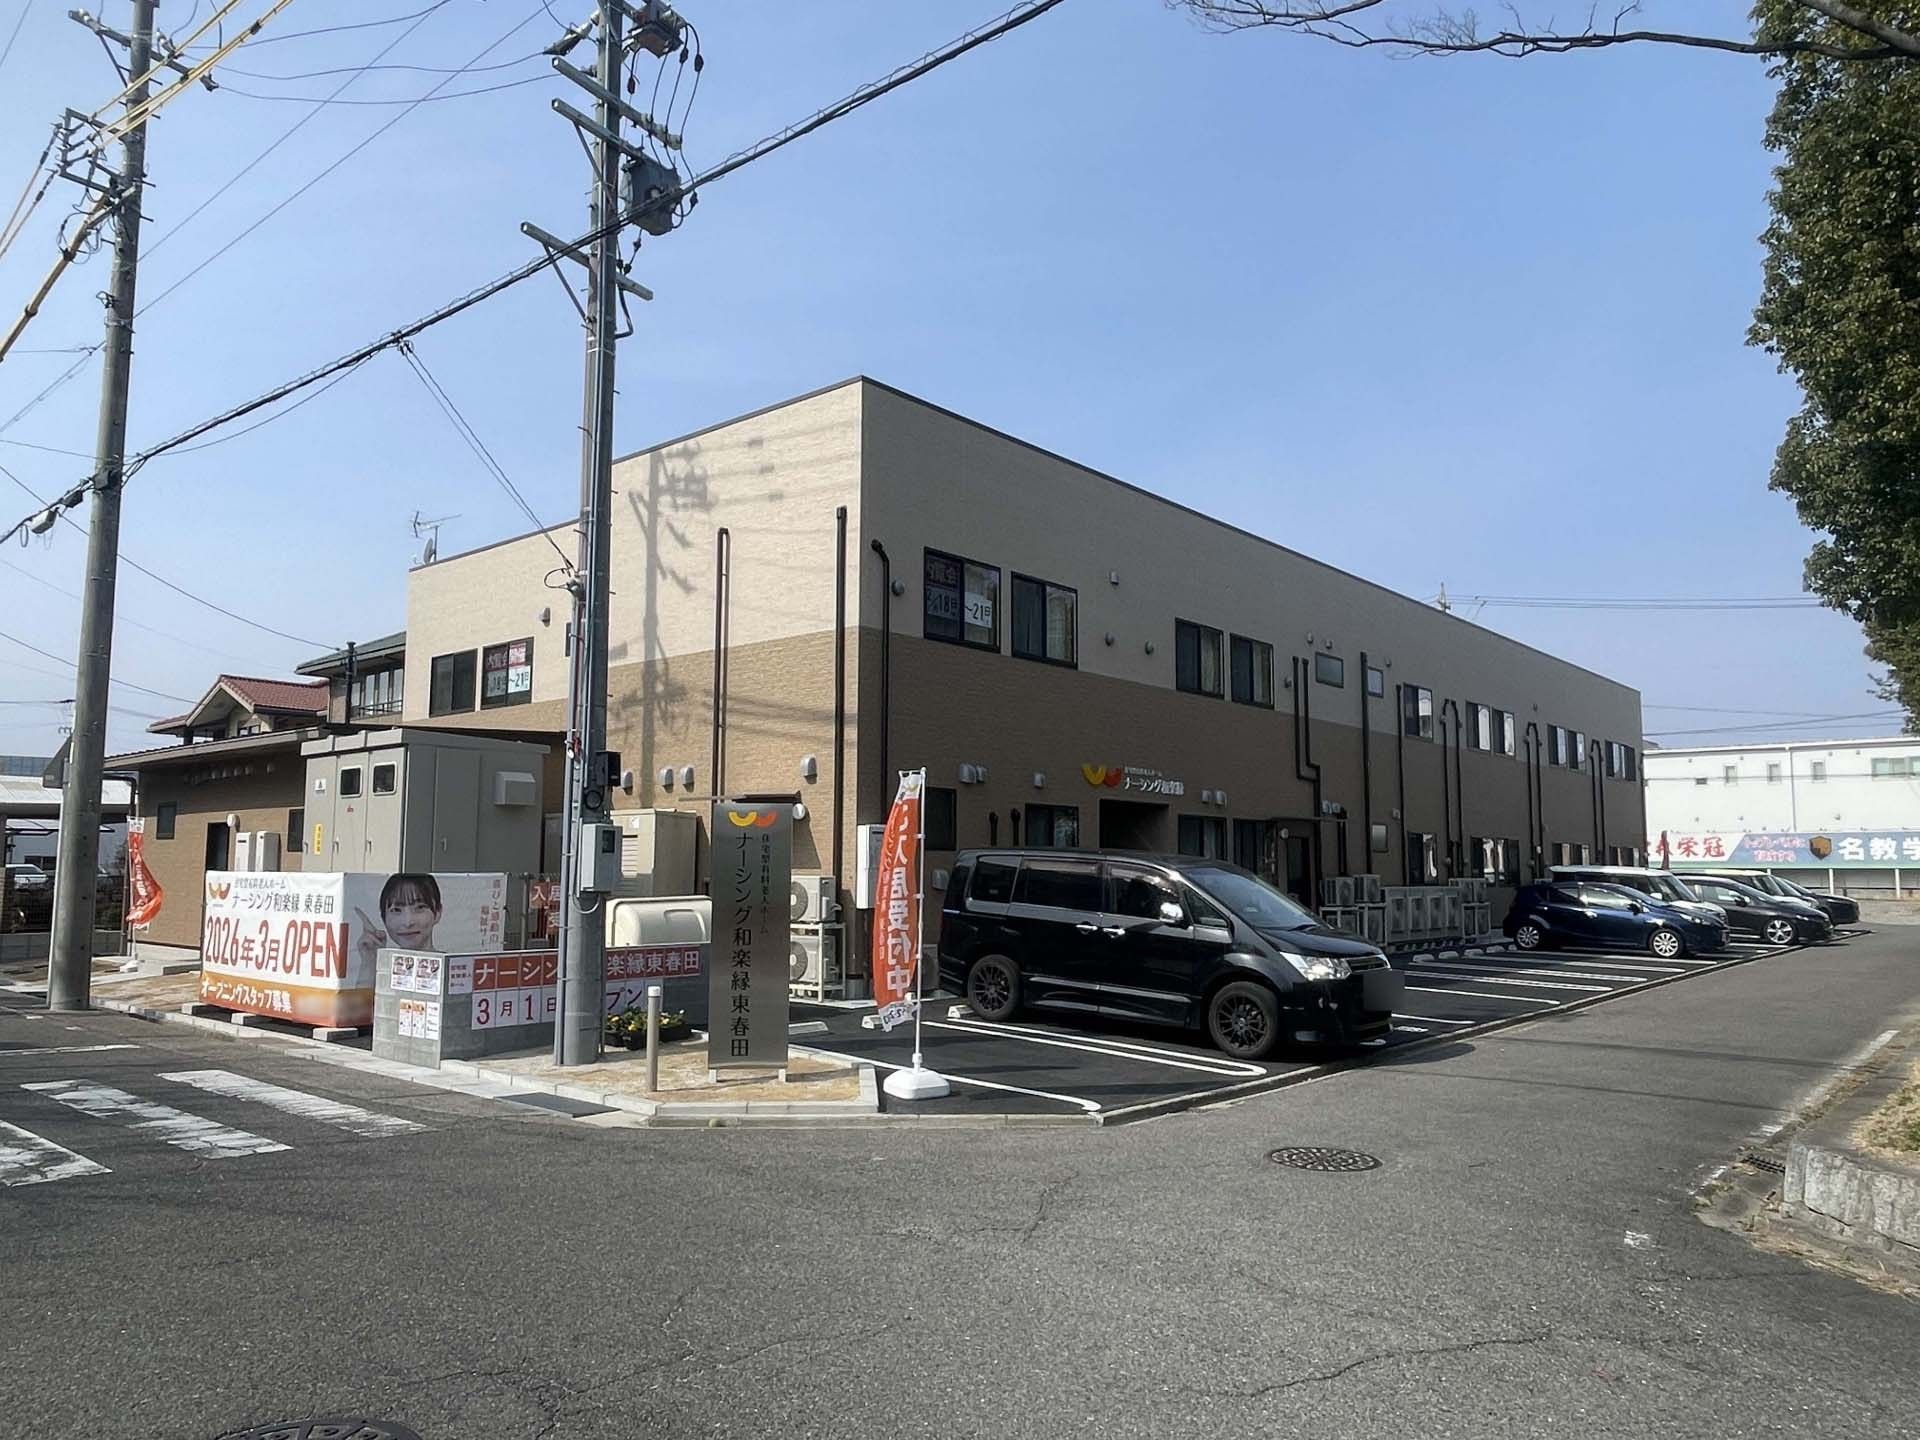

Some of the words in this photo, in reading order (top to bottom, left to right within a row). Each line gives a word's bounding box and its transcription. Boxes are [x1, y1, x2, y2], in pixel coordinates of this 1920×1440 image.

[303, 894, 334, 914] 東春田
[731, 832, 753, 1057] ナーシング和楽縁東春田
[201, 977, 293, 1013] オープニングスタッフ募集
